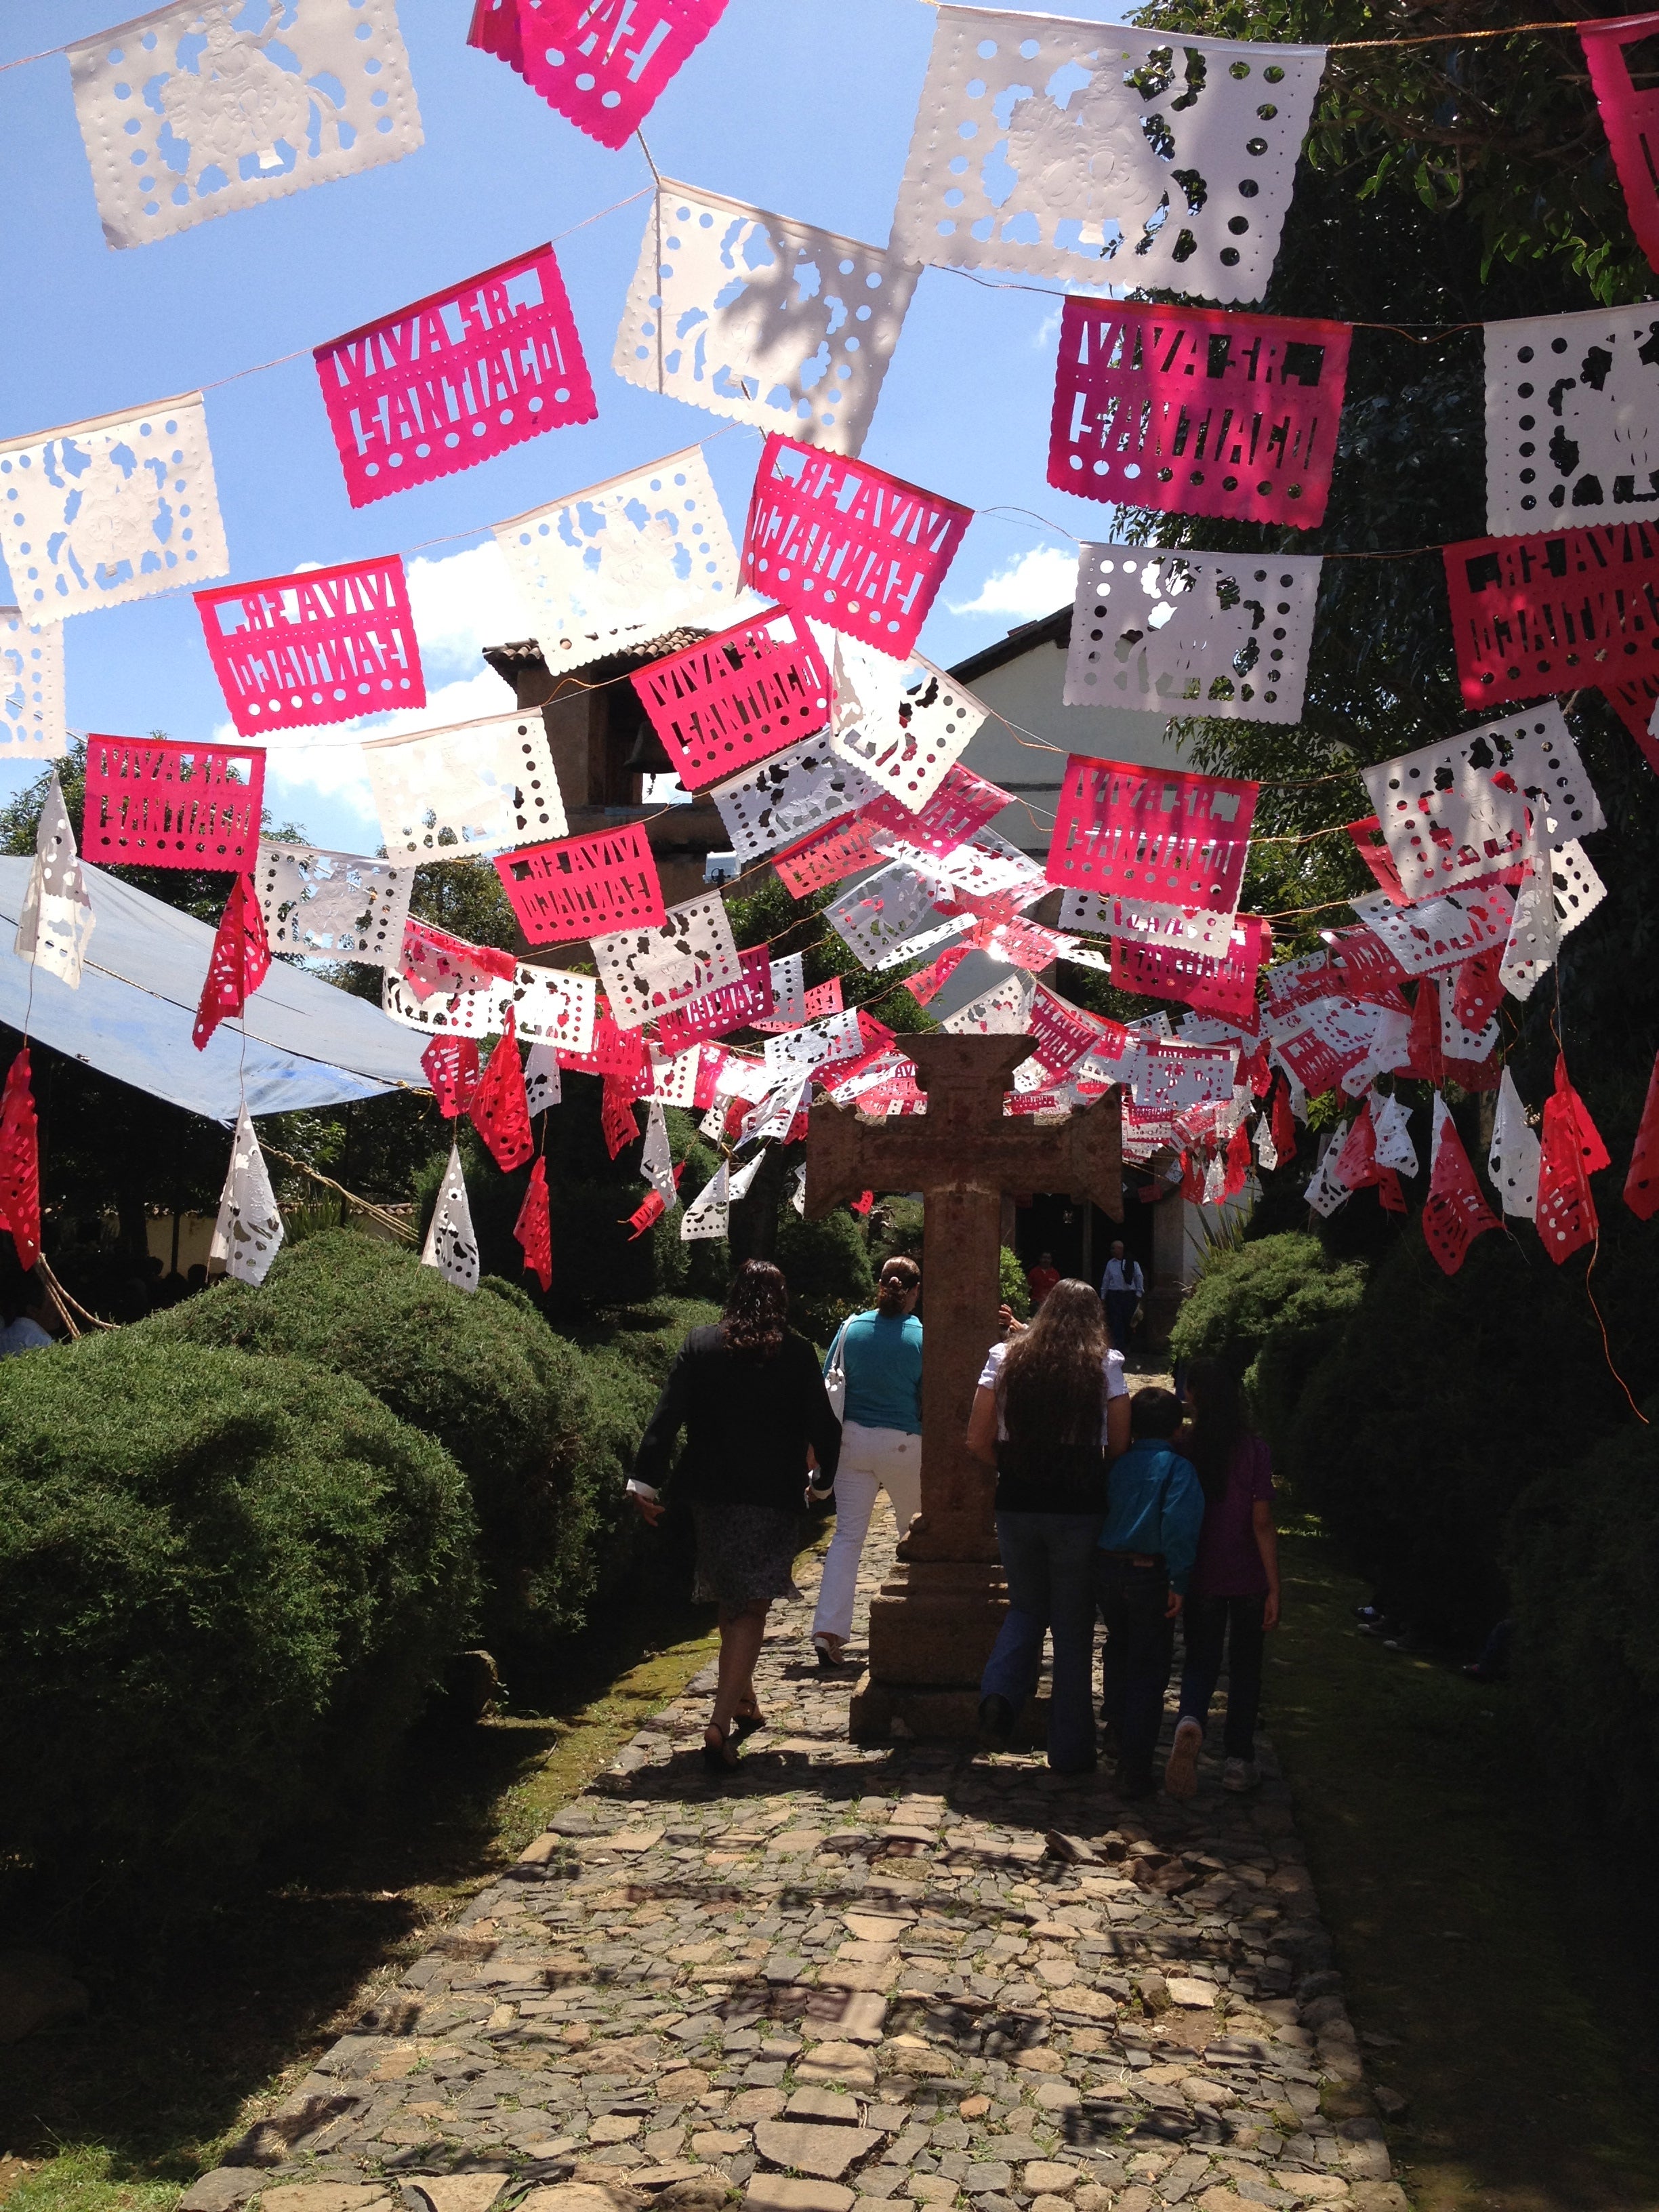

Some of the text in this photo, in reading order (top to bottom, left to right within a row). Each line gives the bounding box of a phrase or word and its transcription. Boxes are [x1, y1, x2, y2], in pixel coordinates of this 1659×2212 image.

[334, 314, 450, 385] VIVA
[1085, 321, 1208, 378] VIVA
[354, 327, 564, 455] SANTIAGO
[1078, 392, 1315, 469] SANTIAGO
[649, 651, 731, 705] VIVA
[676, 655, 821, 749] SANTIAGO
[103, 747, 180, 782] VIVA
[1081, 769, 1161, 811] VIVA
